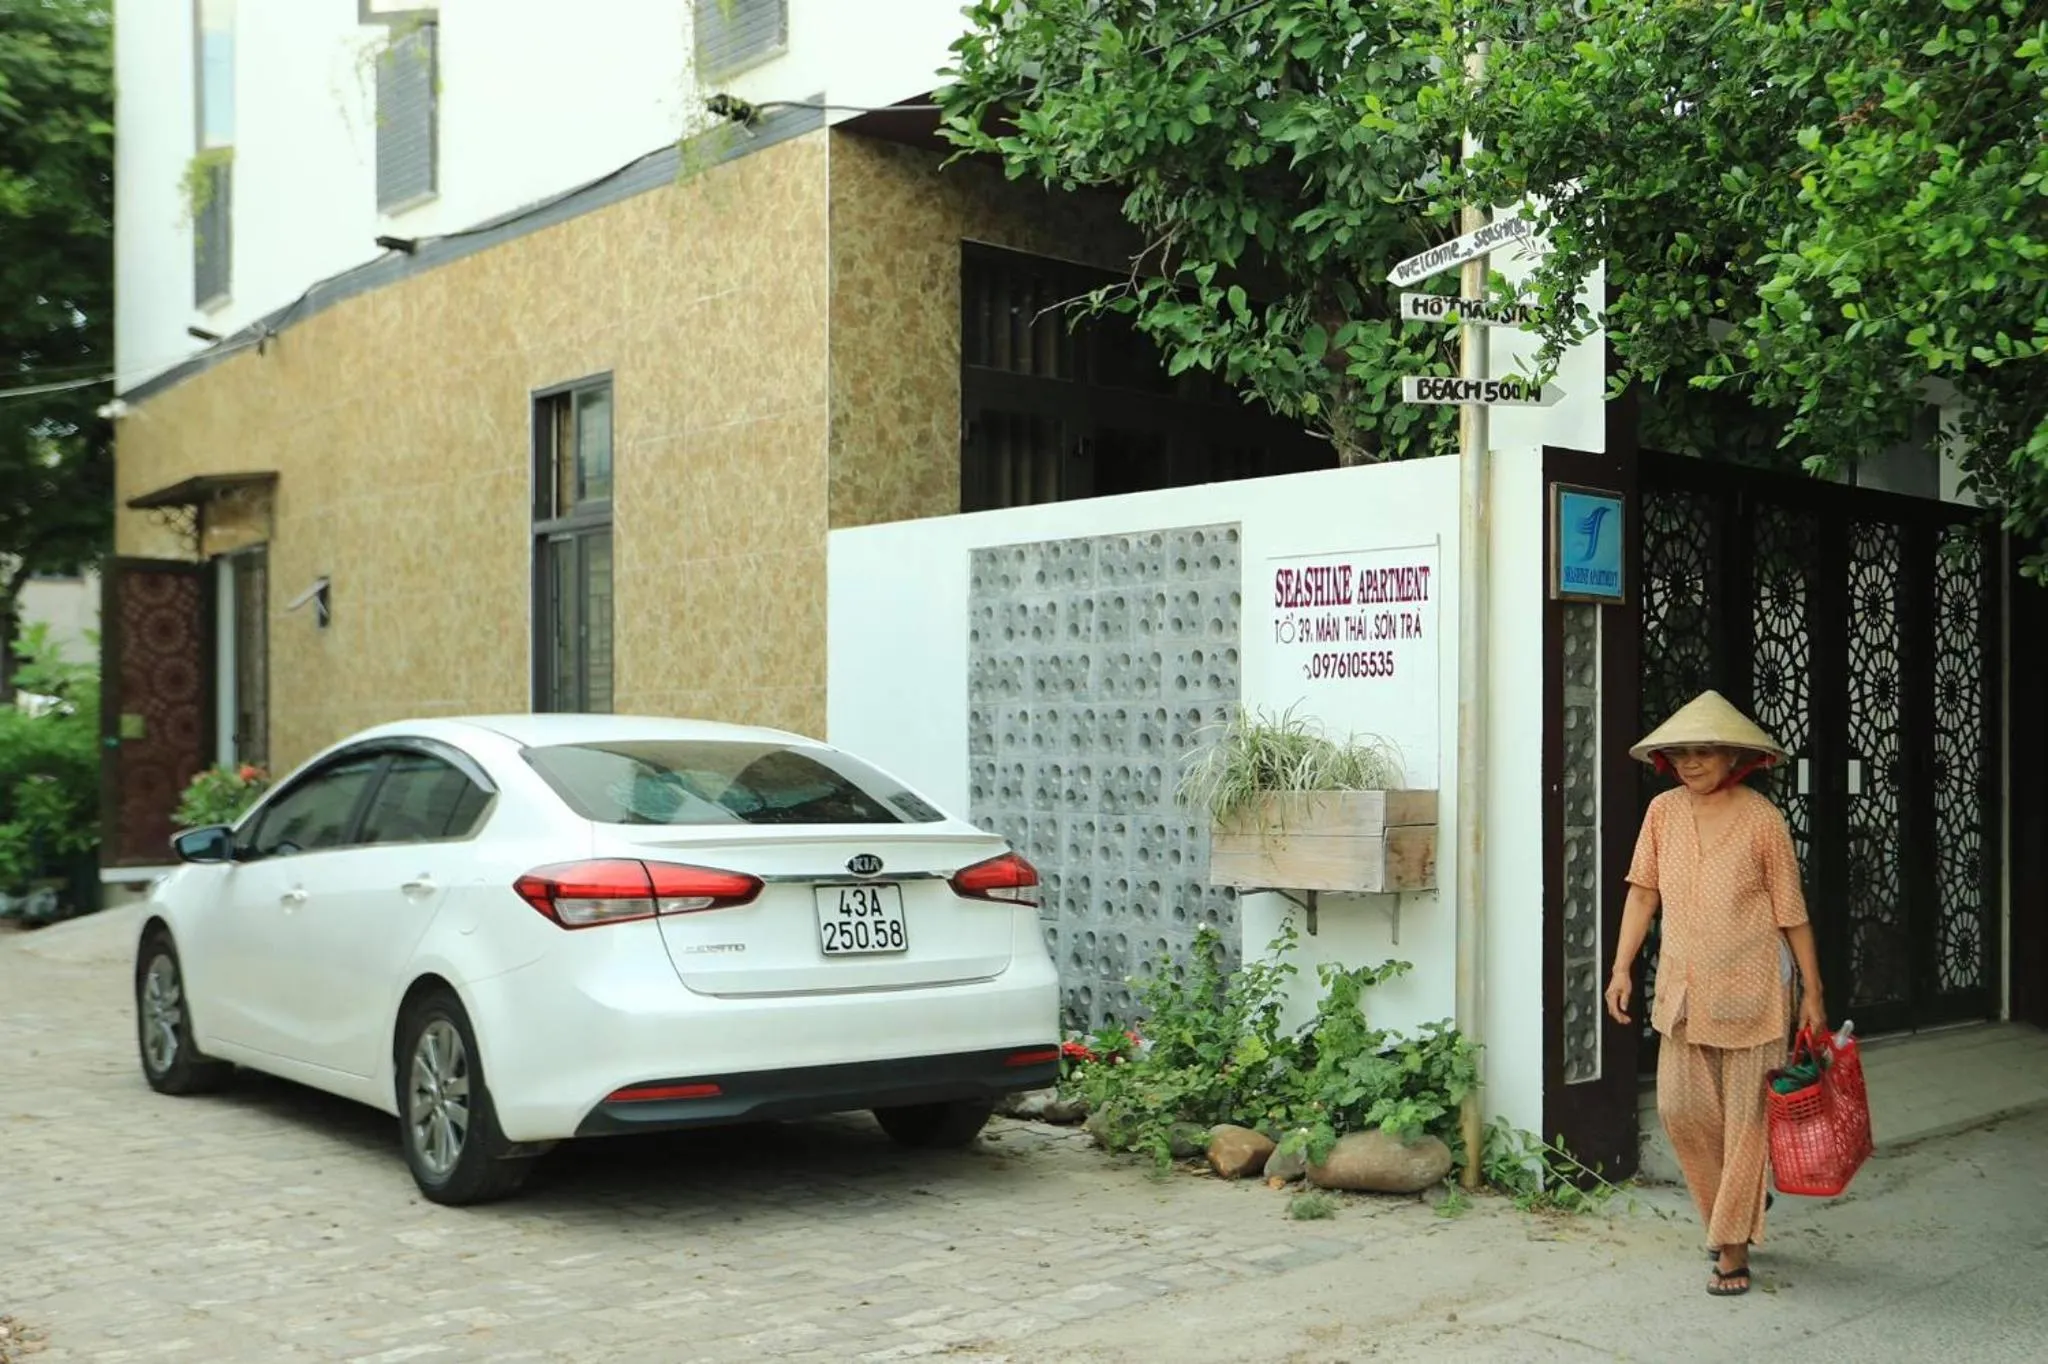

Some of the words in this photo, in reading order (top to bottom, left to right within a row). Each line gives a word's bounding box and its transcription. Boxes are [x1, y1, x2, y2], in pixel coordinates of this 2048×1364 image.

[1416, 378, 1482, 401] BEACH
[1275, 565, 1352, 608] SEASHINE
[1357, 566, 1431, 604] APARTMENT
[1312, 650, 1394, 679] 0976105535
[852, 856, 880, 872] KIA
[839, 888, 883, 918] 43A
[823, 919, 903, 951] 250.58
